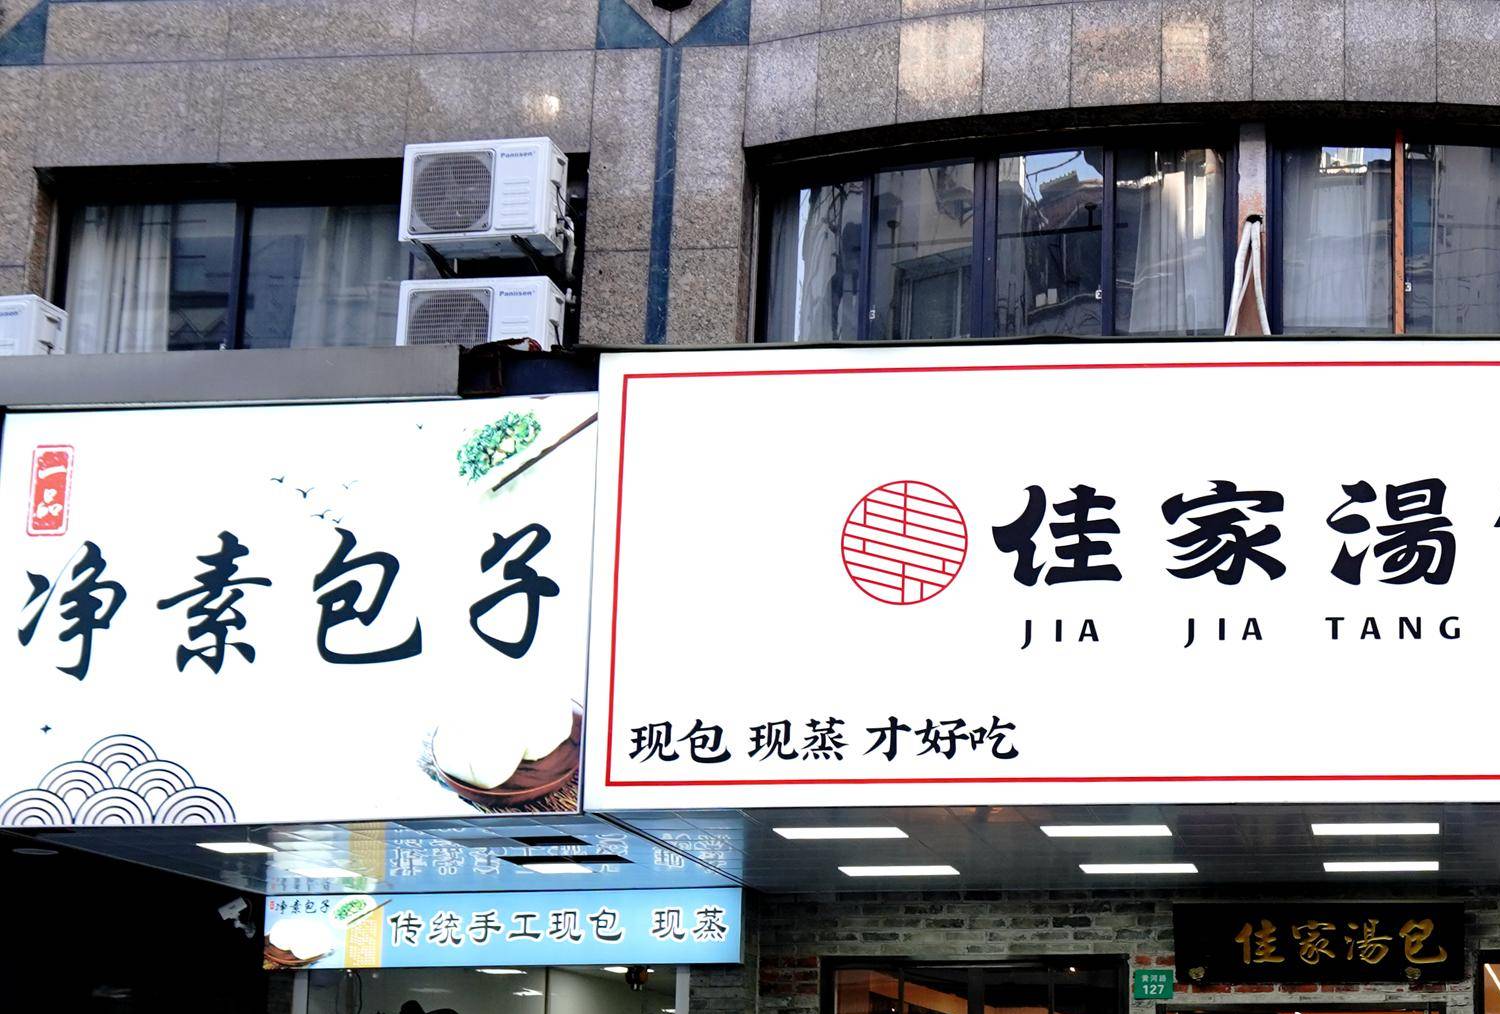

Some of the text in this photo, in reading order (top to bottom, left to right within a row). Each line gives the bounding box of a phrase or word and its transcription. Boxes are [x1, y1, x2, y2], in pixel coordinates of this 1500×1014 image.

[18, 523, 560, 682] 净素包子
[1020, 618, 1100, 650] JIA
[1183, 617, 1263, 649] JIA
[1324, 615, 1461, 640] TANG
[628, 715, 1019, 764] 现包 现蒸 才好吃
[388, 905, 625, 946] 传统手工现包
[649, 903, 729, 943] 现蒸
[1234, 918, 1449, 967] 佳家湯包
[1142, 984, 1166, 995] 127
